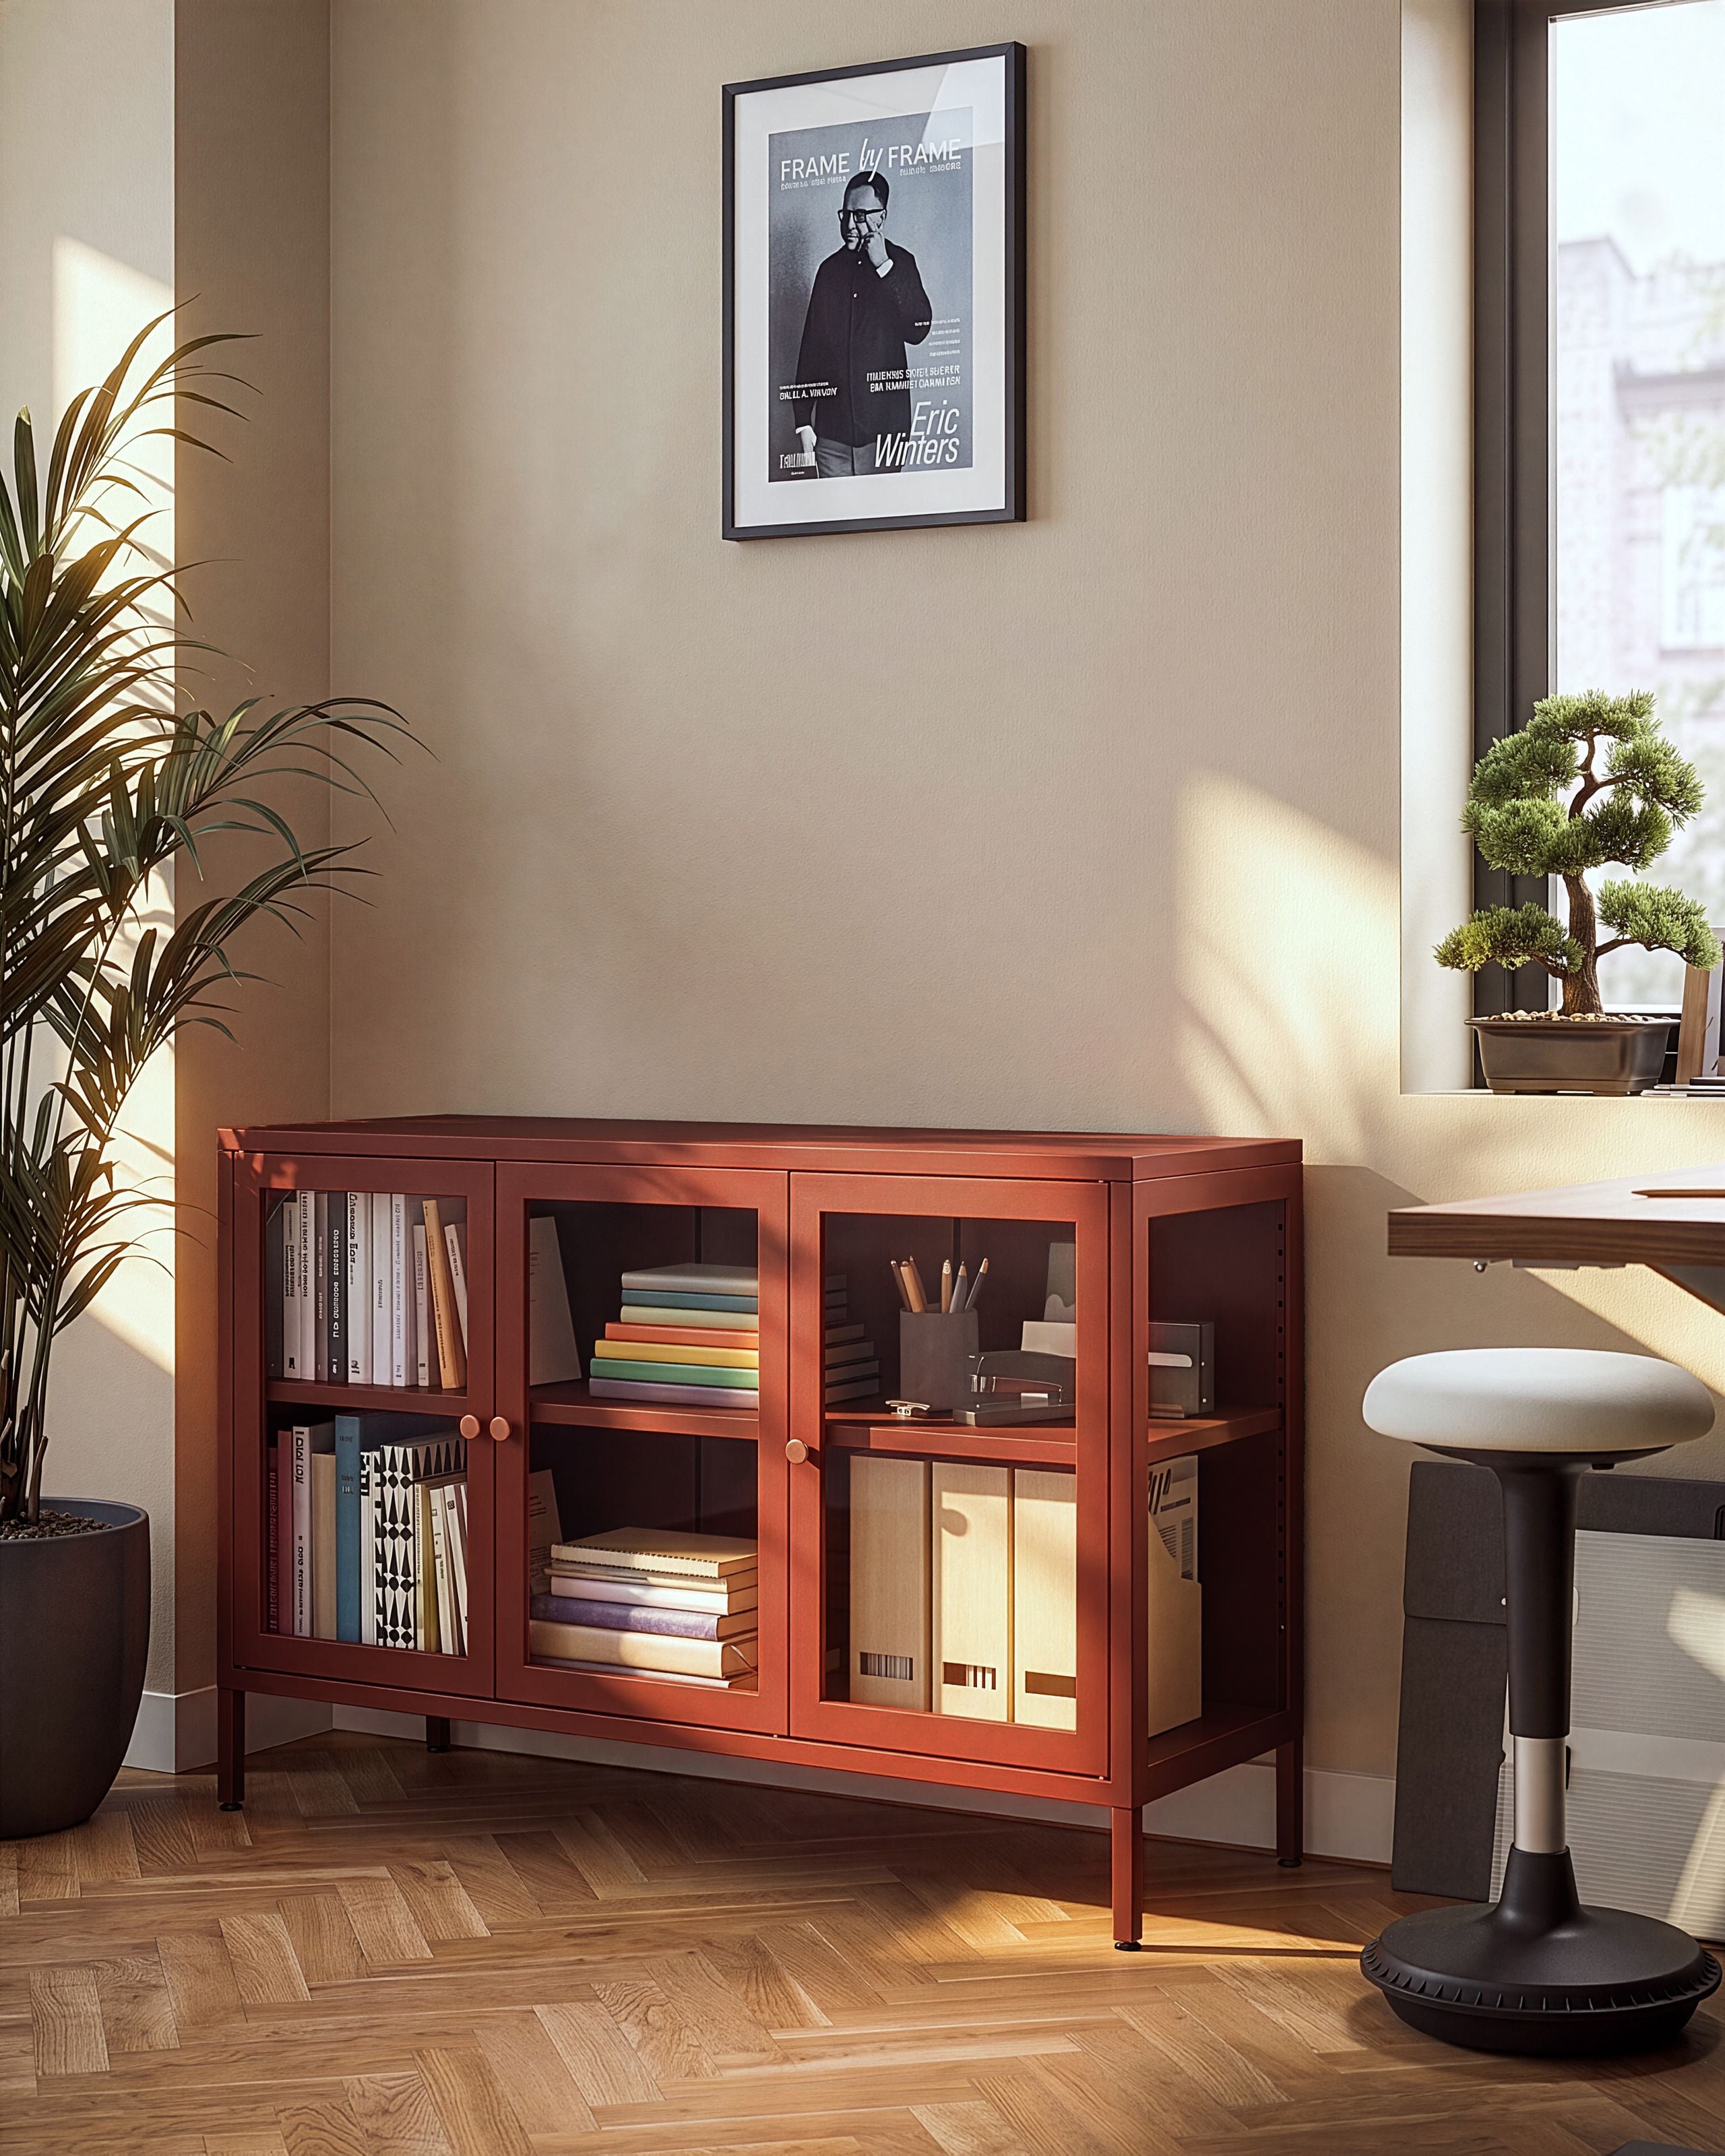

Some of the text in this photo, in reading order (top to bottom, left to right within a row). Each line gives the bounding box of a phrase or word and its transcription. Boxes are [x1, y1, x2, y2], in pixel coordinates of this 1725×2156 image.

[780, 152, 850, 182] FRAME
[858, 137, 884, 183] by
[887, 137, 962, 168] FRAME
[910, 399, 960, 437] Eric
[874, 432, 960, 468] Winters
